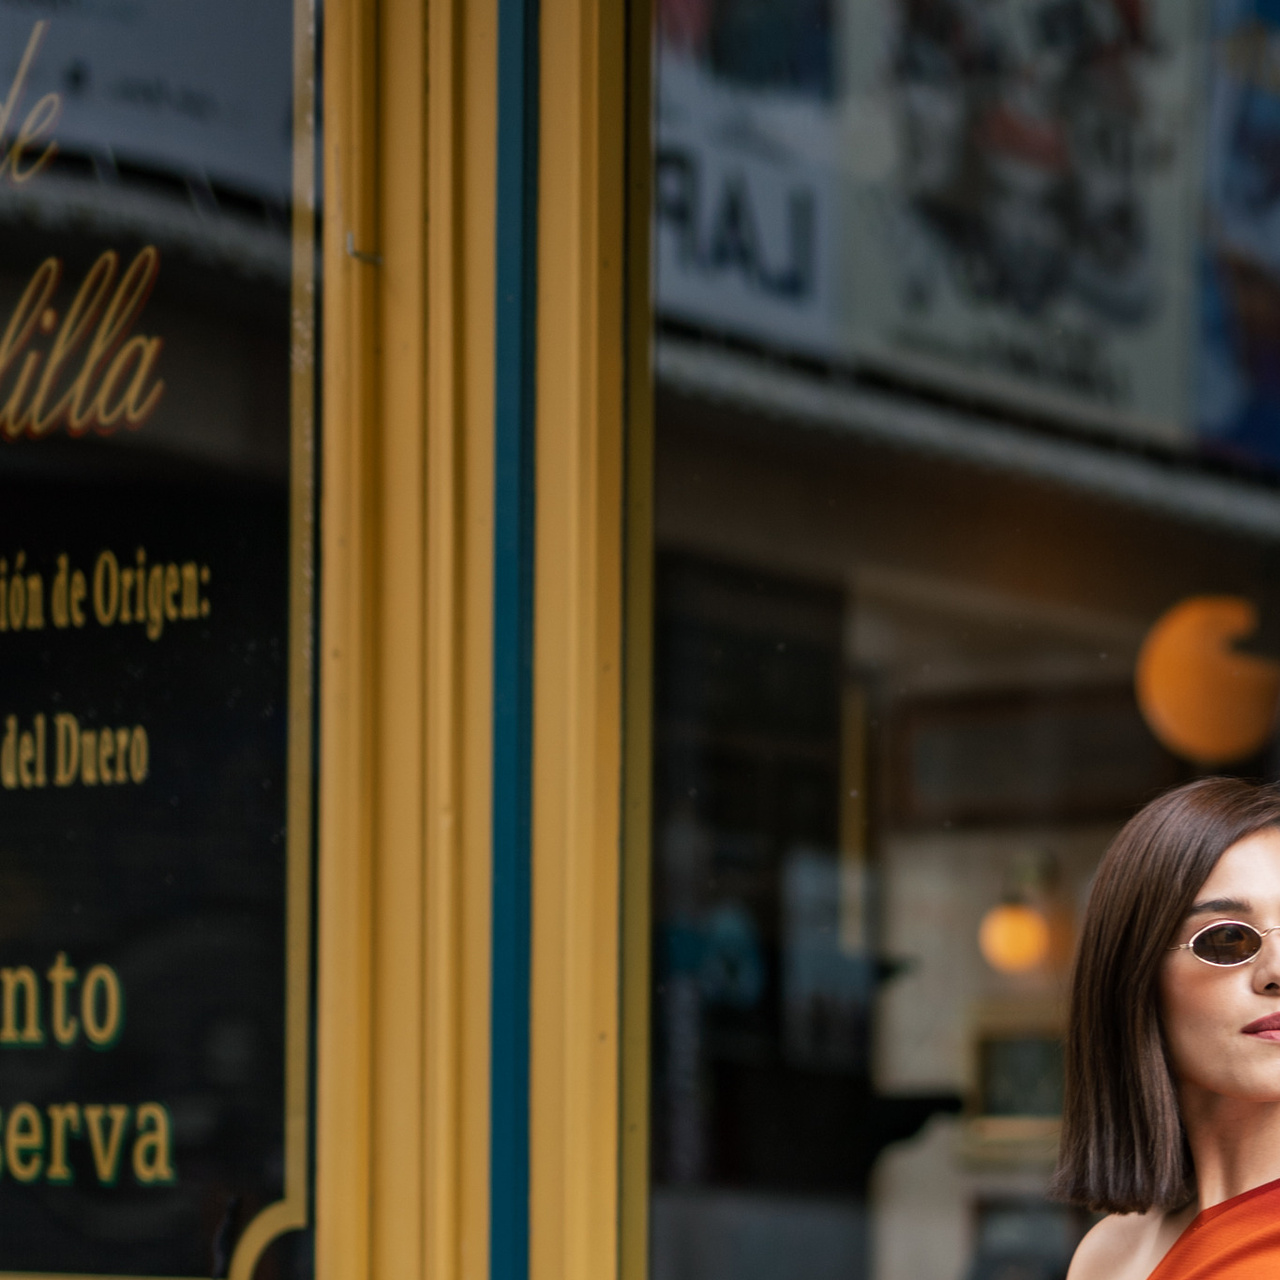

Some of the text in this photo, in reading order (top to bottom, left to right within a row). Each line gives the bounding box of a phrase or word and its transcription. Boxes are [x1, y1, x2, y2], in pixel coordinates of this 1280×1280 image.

[51, 552, 86, 629] de
[93, 545, 210, 641] Origen:
[0, 713, 149, 790] del Duero
